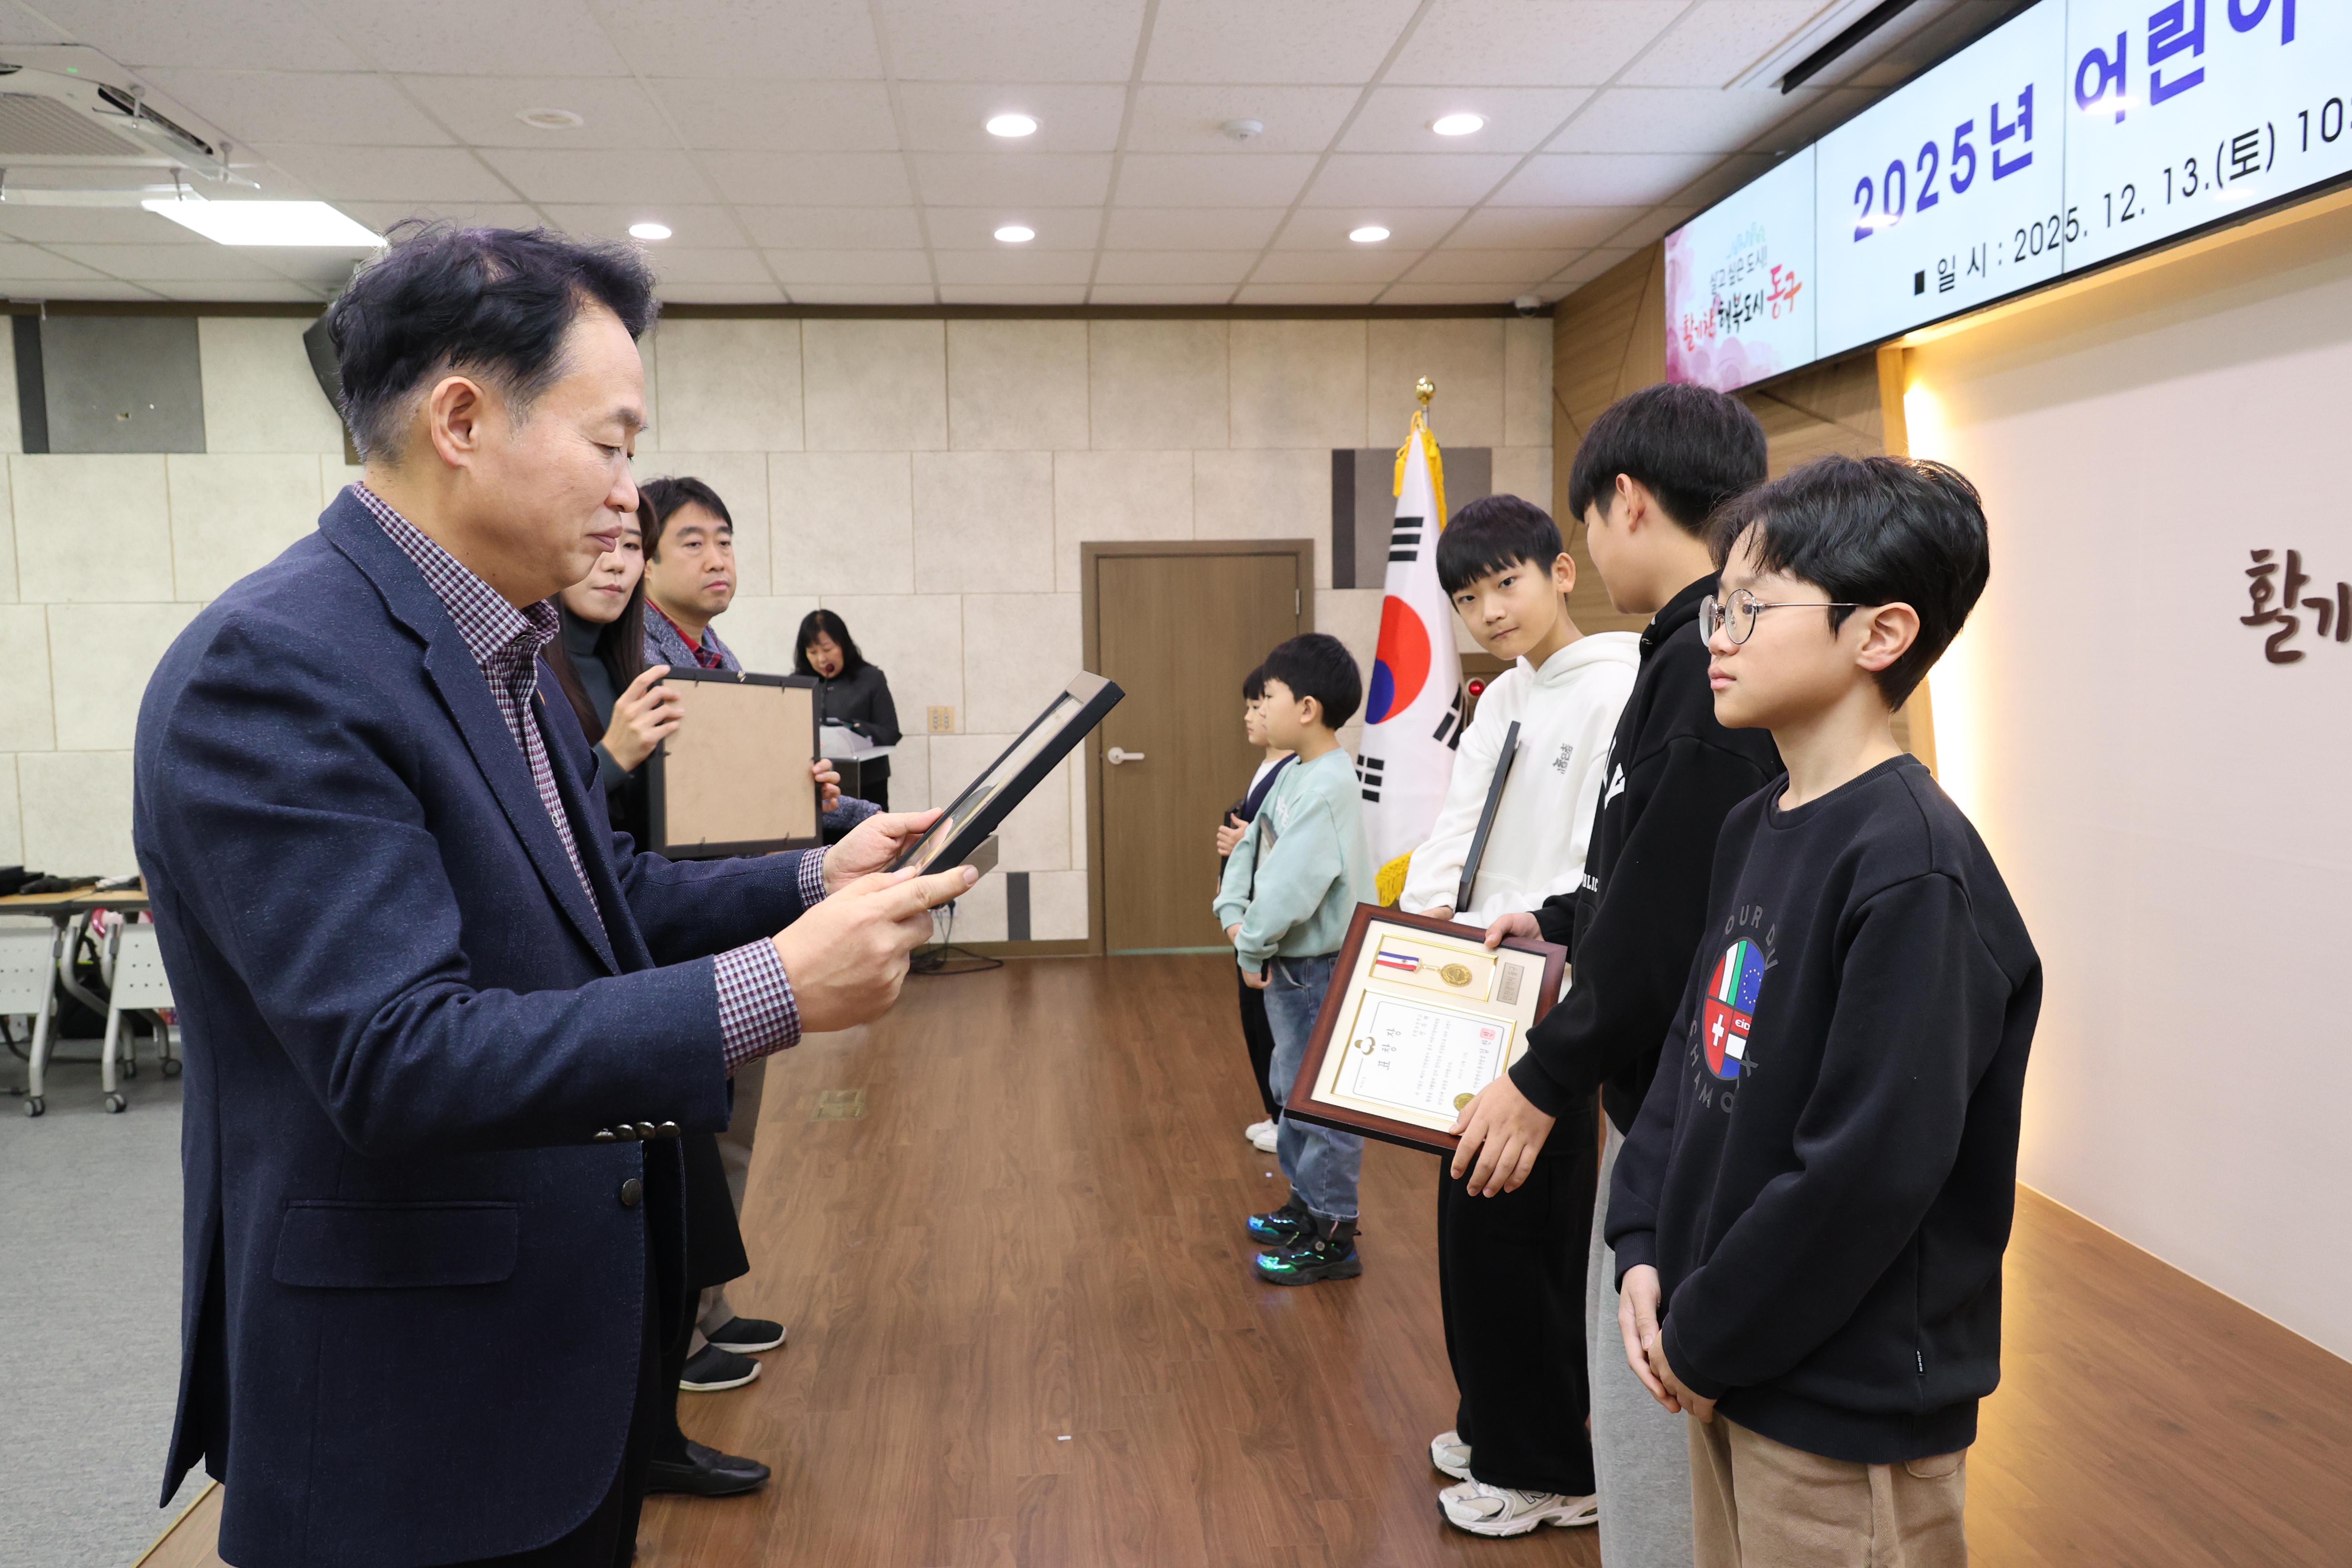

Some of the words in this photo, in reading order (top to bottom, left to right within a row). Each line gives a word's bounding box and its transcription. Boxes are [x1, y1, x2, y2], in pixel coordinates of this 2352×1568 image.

[1854, 83, 2033, 242] 2025년
[2014, 206, 2088, 263] 2025.
[2104, 183, 2145, 228] 12.
[2163, 121, 2274, 205] 13.(토)
[1683, 307, 1716, 351] 활기찬
[1718, 289, 1765, 333] 행복도시
[1767, 264, 1802, 320] 동구
[2240, 549, 2351, 663] 활기
